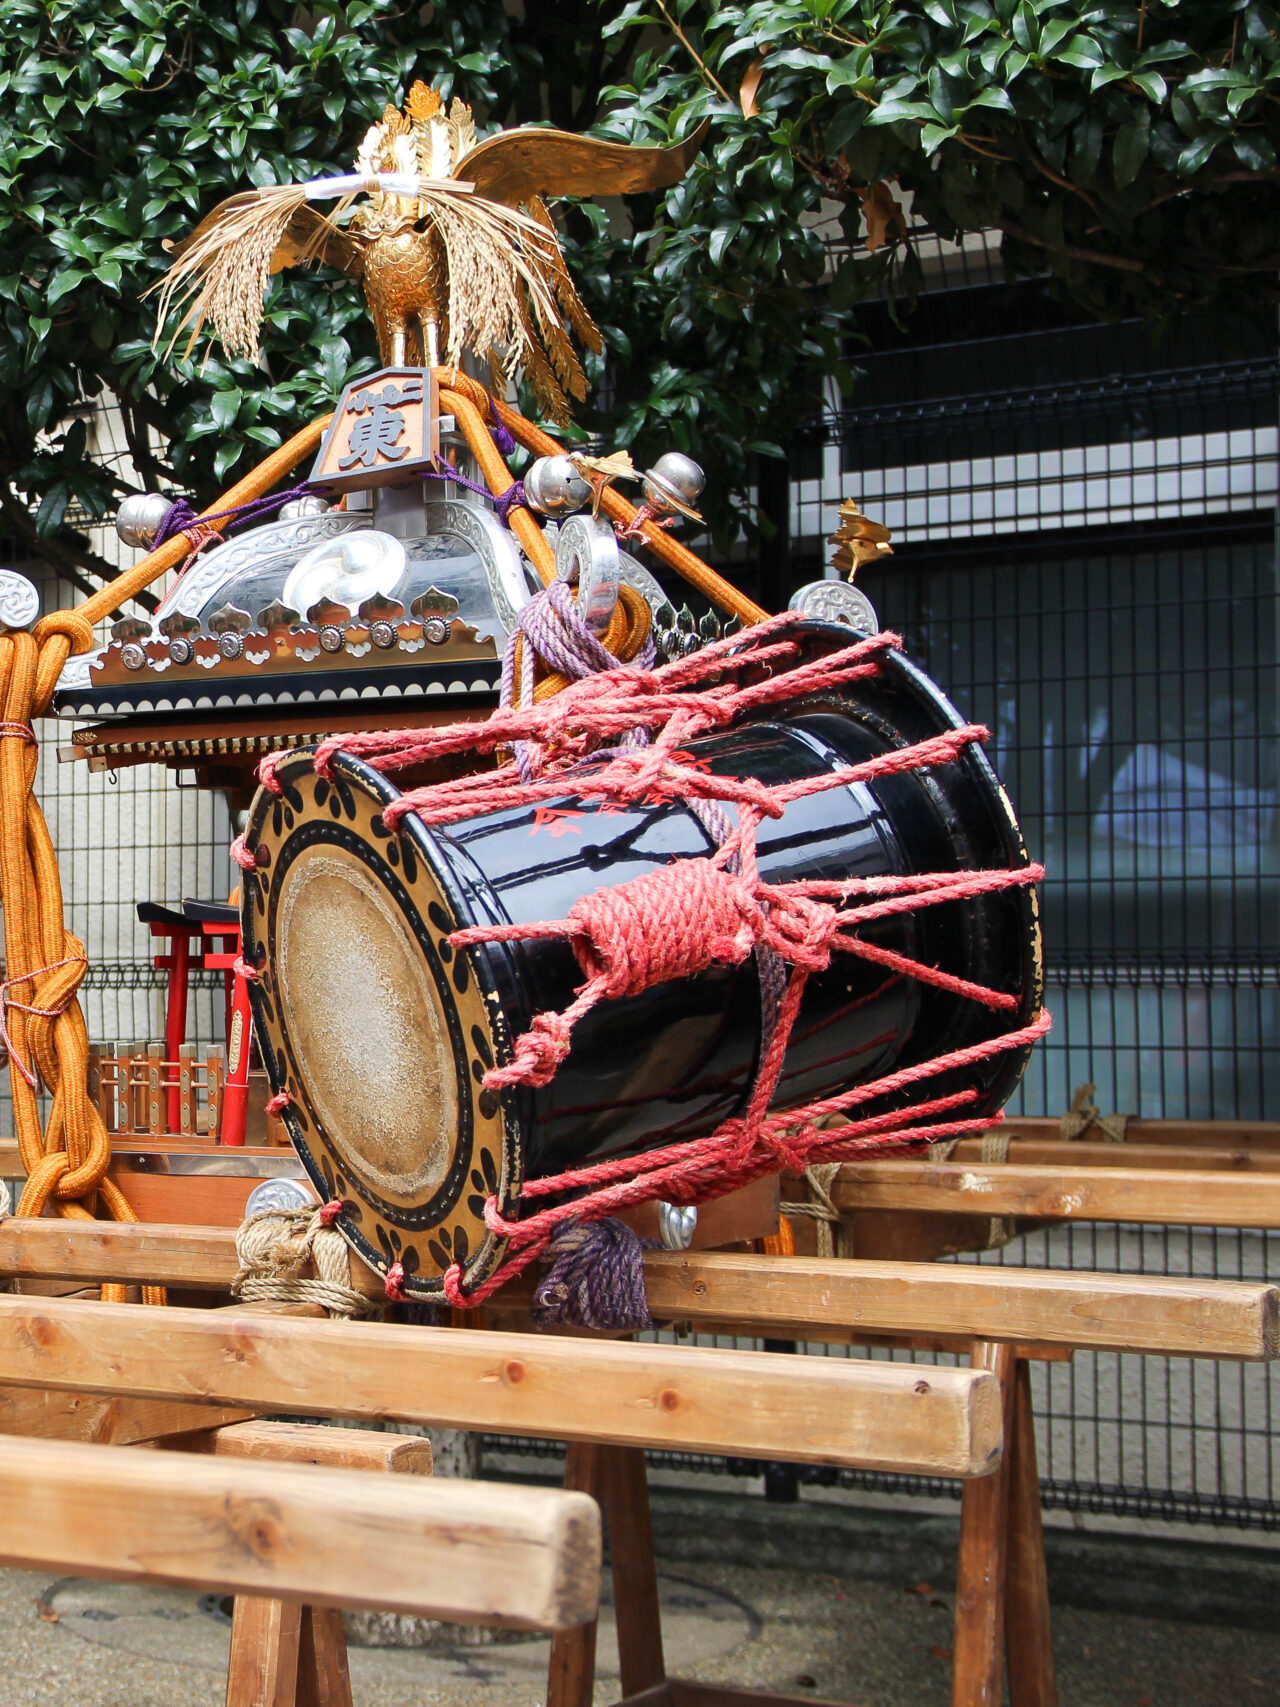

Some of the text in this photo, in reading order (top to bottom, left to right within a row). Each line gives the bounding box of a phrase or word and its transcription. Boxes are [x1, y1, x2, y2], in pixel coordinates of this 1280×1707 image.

[346, 380, 423, 413] 小山二
[338, 406, 411, 470] 東
